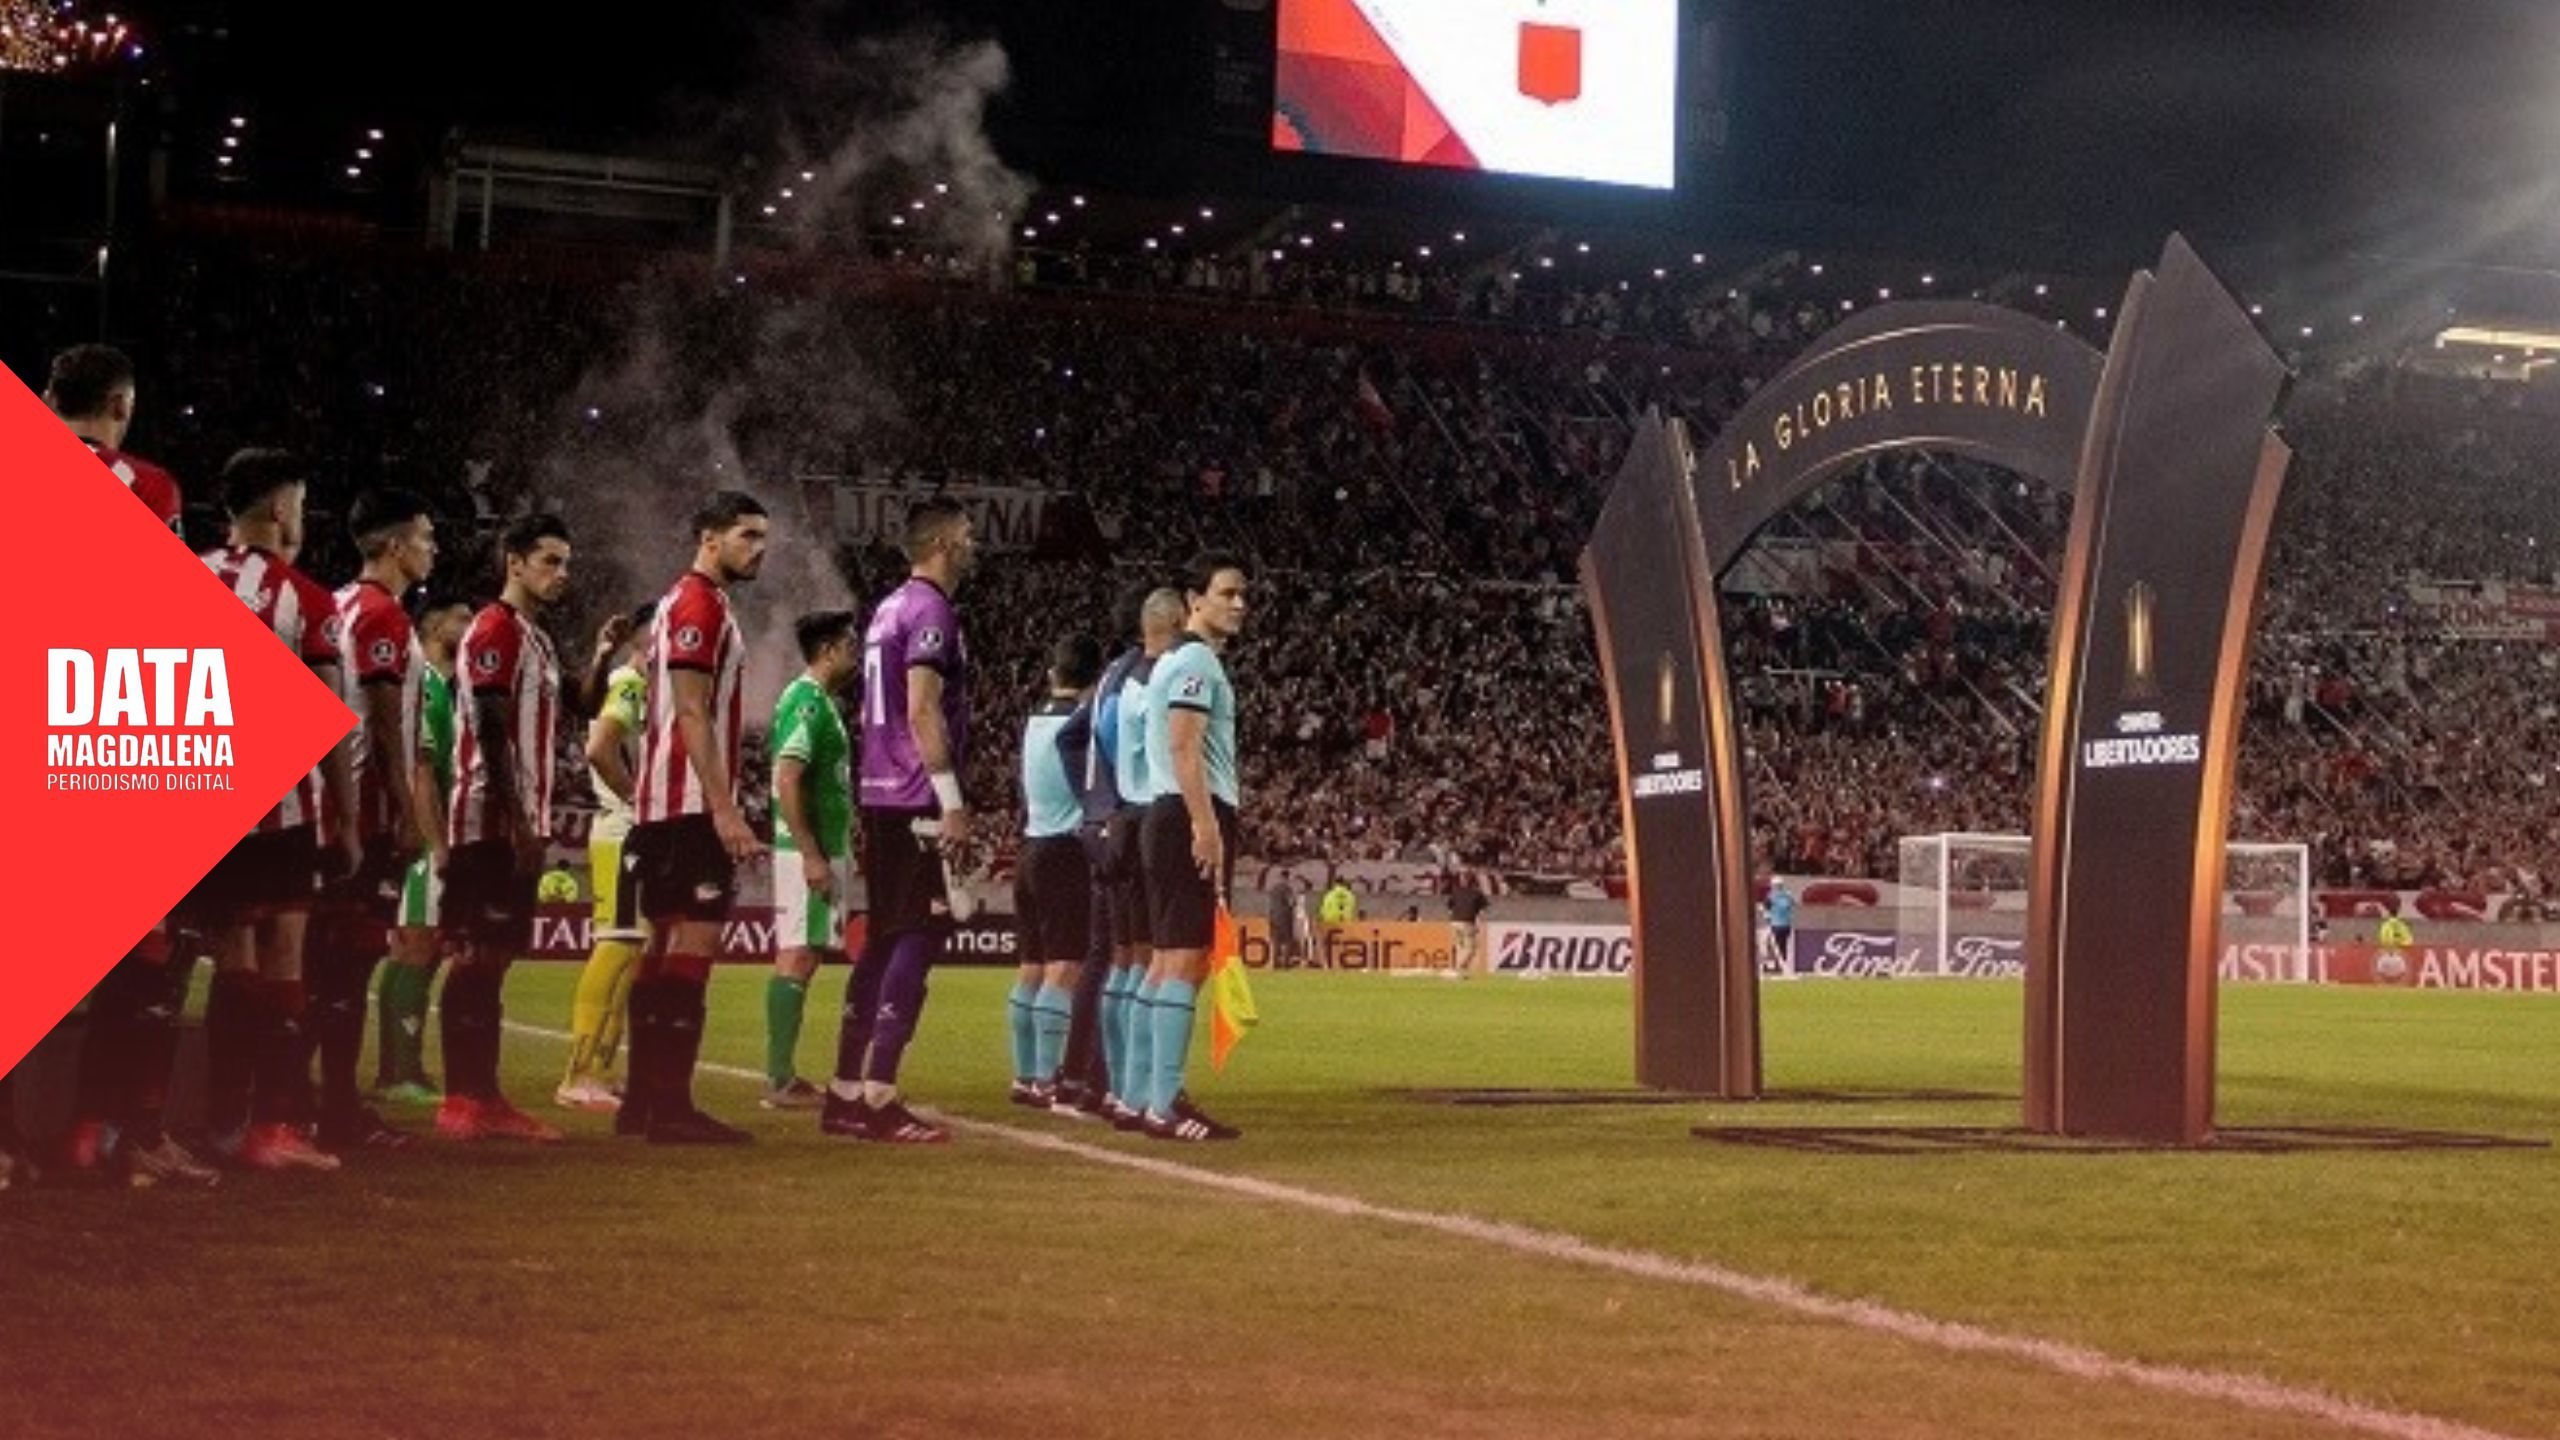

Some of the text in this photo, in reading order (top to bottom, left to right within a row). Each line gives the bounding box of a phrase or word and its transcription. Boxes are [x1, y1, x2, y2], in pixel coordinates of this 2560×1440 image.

[1729, 363, 2047, 490] LA GLORIA ETERNA
[1814, 932, 1920, 976] Ford
